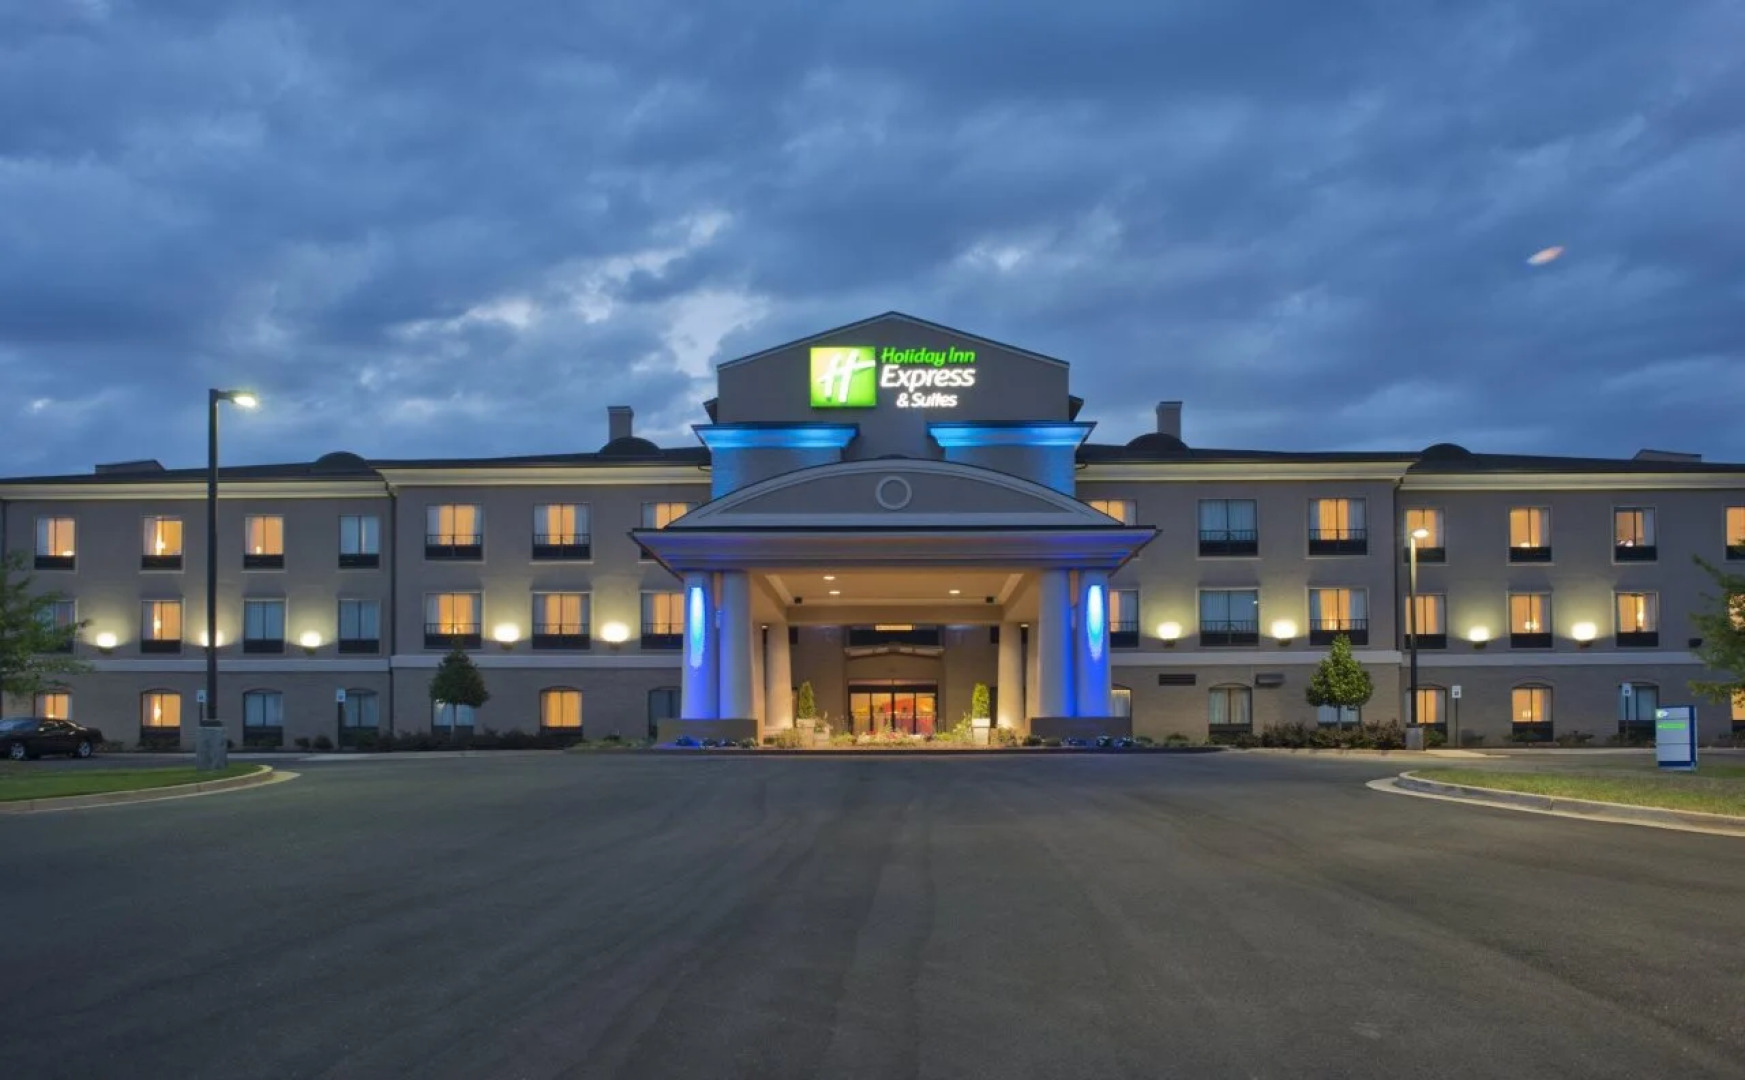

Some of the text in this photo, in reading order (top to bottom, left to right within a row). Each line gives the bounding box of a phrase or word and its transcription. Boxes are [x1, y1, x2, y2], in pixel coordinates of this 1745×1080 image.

[881, 347, 976, 366] Holiday Inn
[880, 364, 976, 392] Express
[896, 392, 957, 408] & Suites
